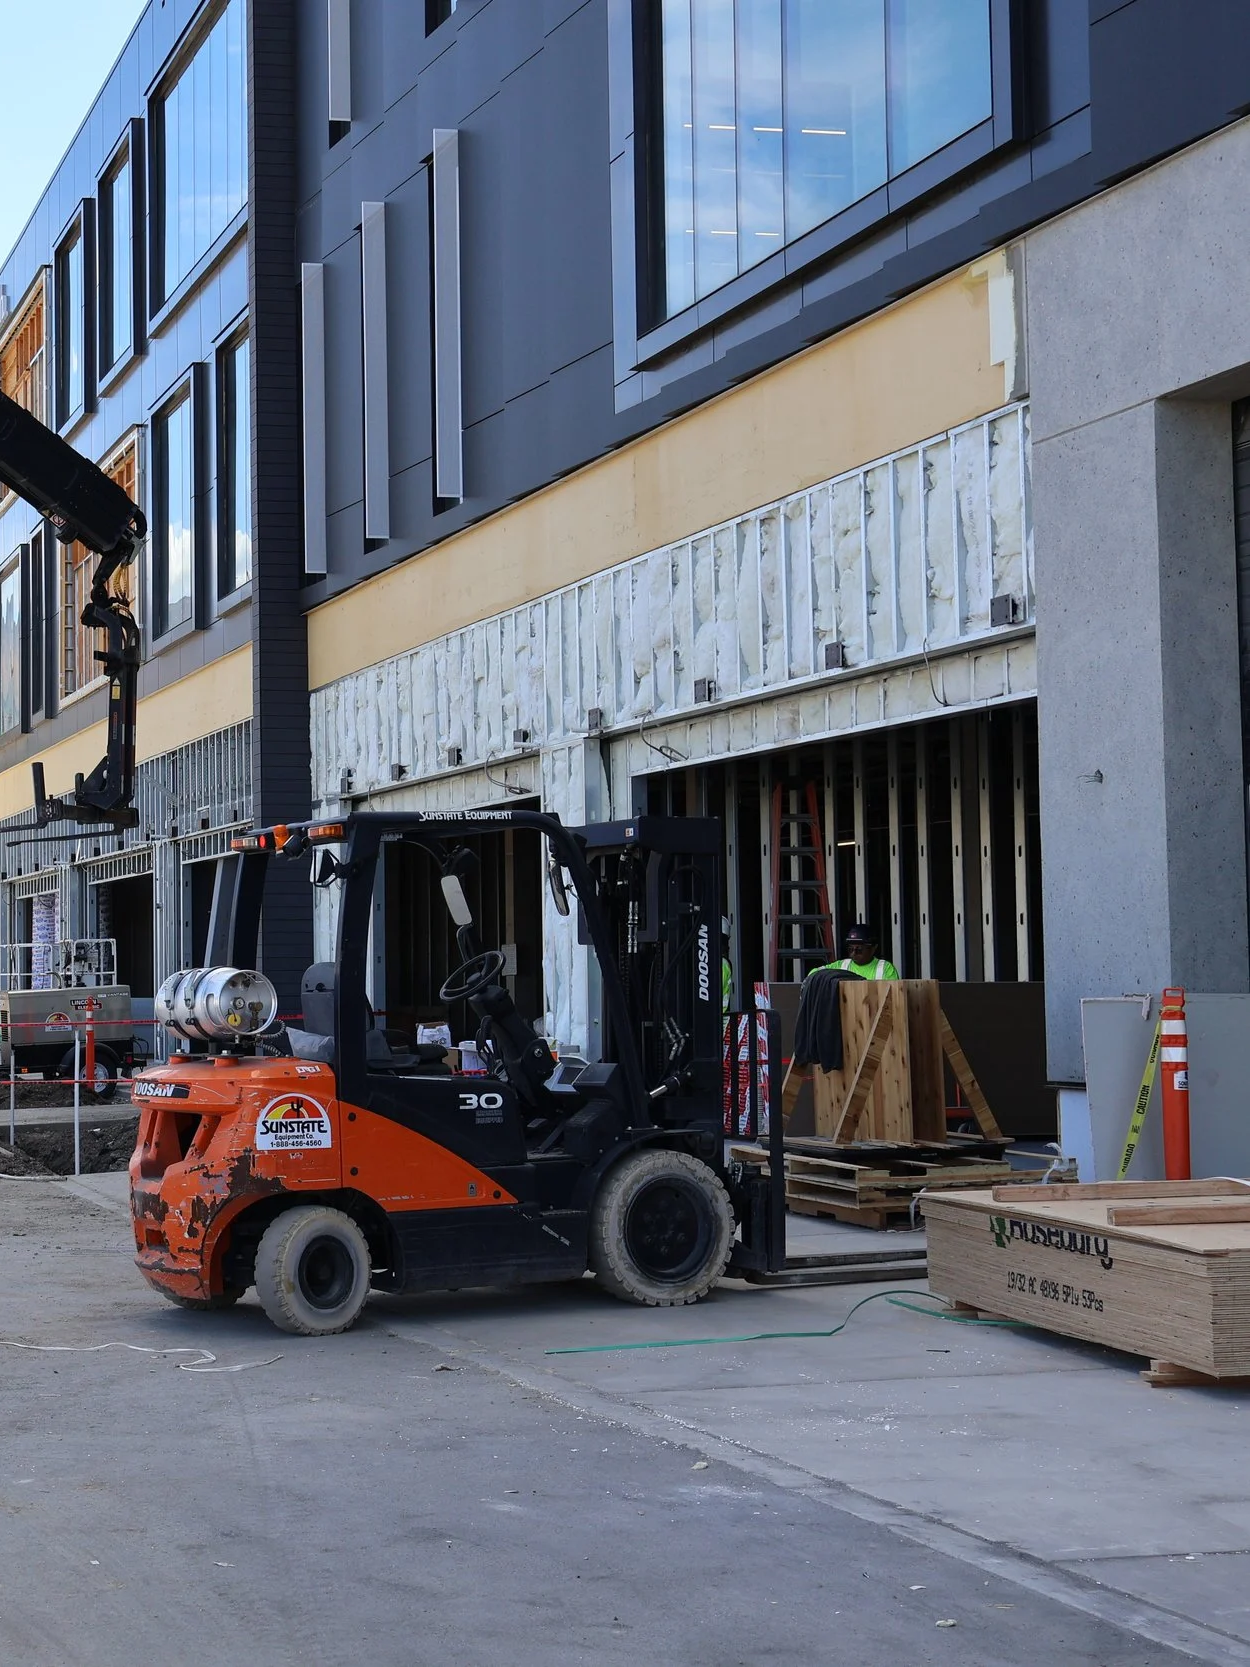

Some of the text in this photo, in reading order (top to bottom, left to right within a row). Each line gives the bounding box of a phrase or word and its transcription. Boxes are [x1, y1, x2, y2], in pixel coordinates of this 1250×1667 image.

[419, 810, 512, 822] SUNSTATE EQUIPMENT
[698, 923, 710, 1002] DOOSAN
[459, 1093, 503, 1110] 30
[1136, 1084, 1150, 1115] CAUTION
[260, 1120, 328, 1135] SUNSTATE
[270, 1140, 322, 1148] 1-888-456-4560
[1007, 1271, 1026, 1292] 19/32
[1028, 1276, 1037, 1295] AC
[1062, 1285, 1079, 1305] 5Ply
